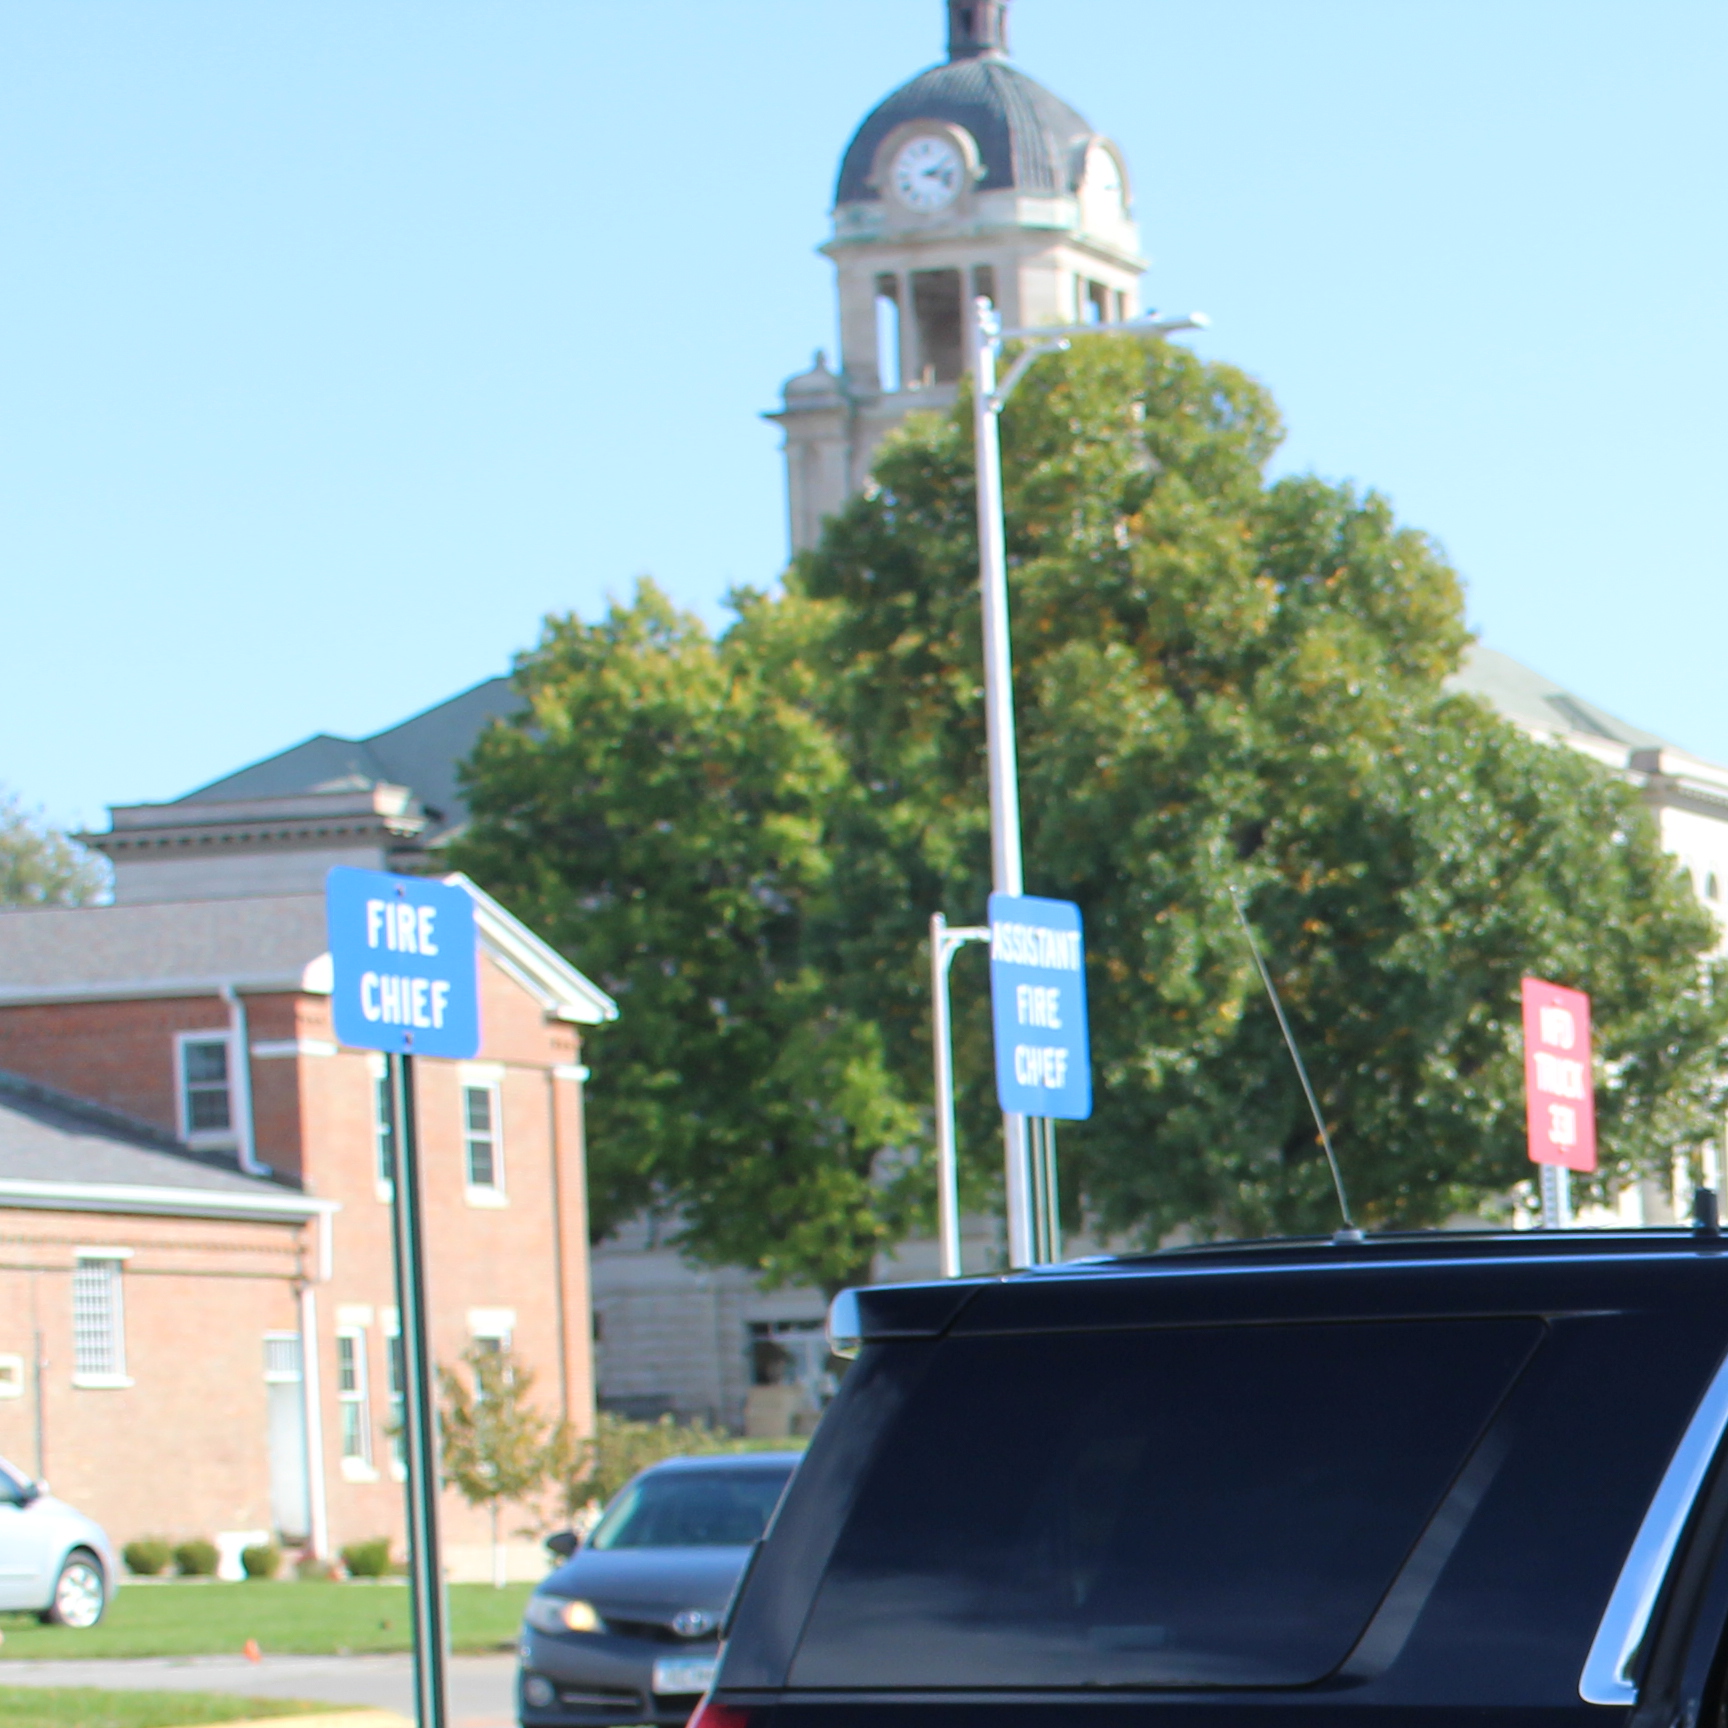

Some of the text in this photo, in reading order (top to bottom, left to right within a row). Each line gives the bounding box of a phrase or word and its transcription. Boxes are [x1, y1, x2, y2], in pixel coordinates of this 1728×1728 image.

[365, 898, 439, 956] FIRE
[991, 921, 1081, 972] ASSISTANT
[360, 970, 451, 1029] CHIEF
[1016, 984, 1062, 1030] FIRE
[1014, 1043, 1069, 1090] CHIEF
[1532, 1051, 1586, 1100] TRUCK
